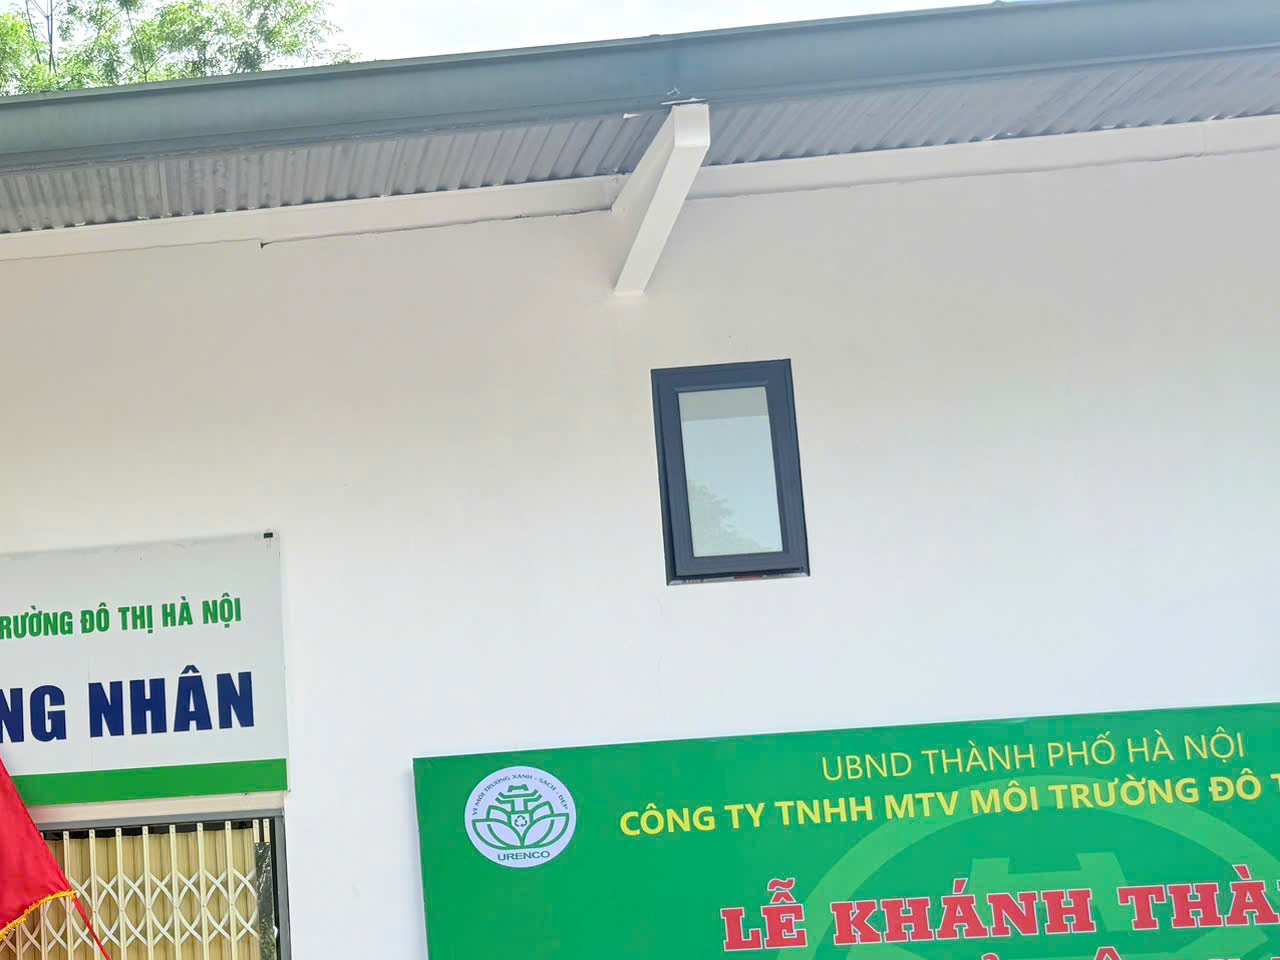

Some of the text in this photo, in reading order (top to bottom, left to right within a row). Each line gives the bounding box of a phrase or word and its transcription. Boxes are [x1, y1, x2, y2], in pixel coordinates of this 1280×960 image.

[80, 602, 110, 634] ĐÔ
[118, 605, 153, 634] THỊ
[161, 596, 194, 628] HÀ
[202, 592, 242, 628] NỘI
[88, 665, 255, 738] NHÂN
[822, 726, 1245, 781] UBND THÀNH PHỐ HÀ NỘI
[620, 803, 716, 836] CÔNG
[724, 803, 766, 829] TY
[775, 797, 873, 826] TNHH
[885, 791, 959, 820] MTV
[971, 780, 1040, 815] MÔI
[1049, 773, 1200, 810] TRƯỜNG
[1208, 767, 1262, 803] ĐÔ
[497, 850, 551, 861] URENCO
[721, 864, 1280, 952] LỄ KHÁNH THÀ
